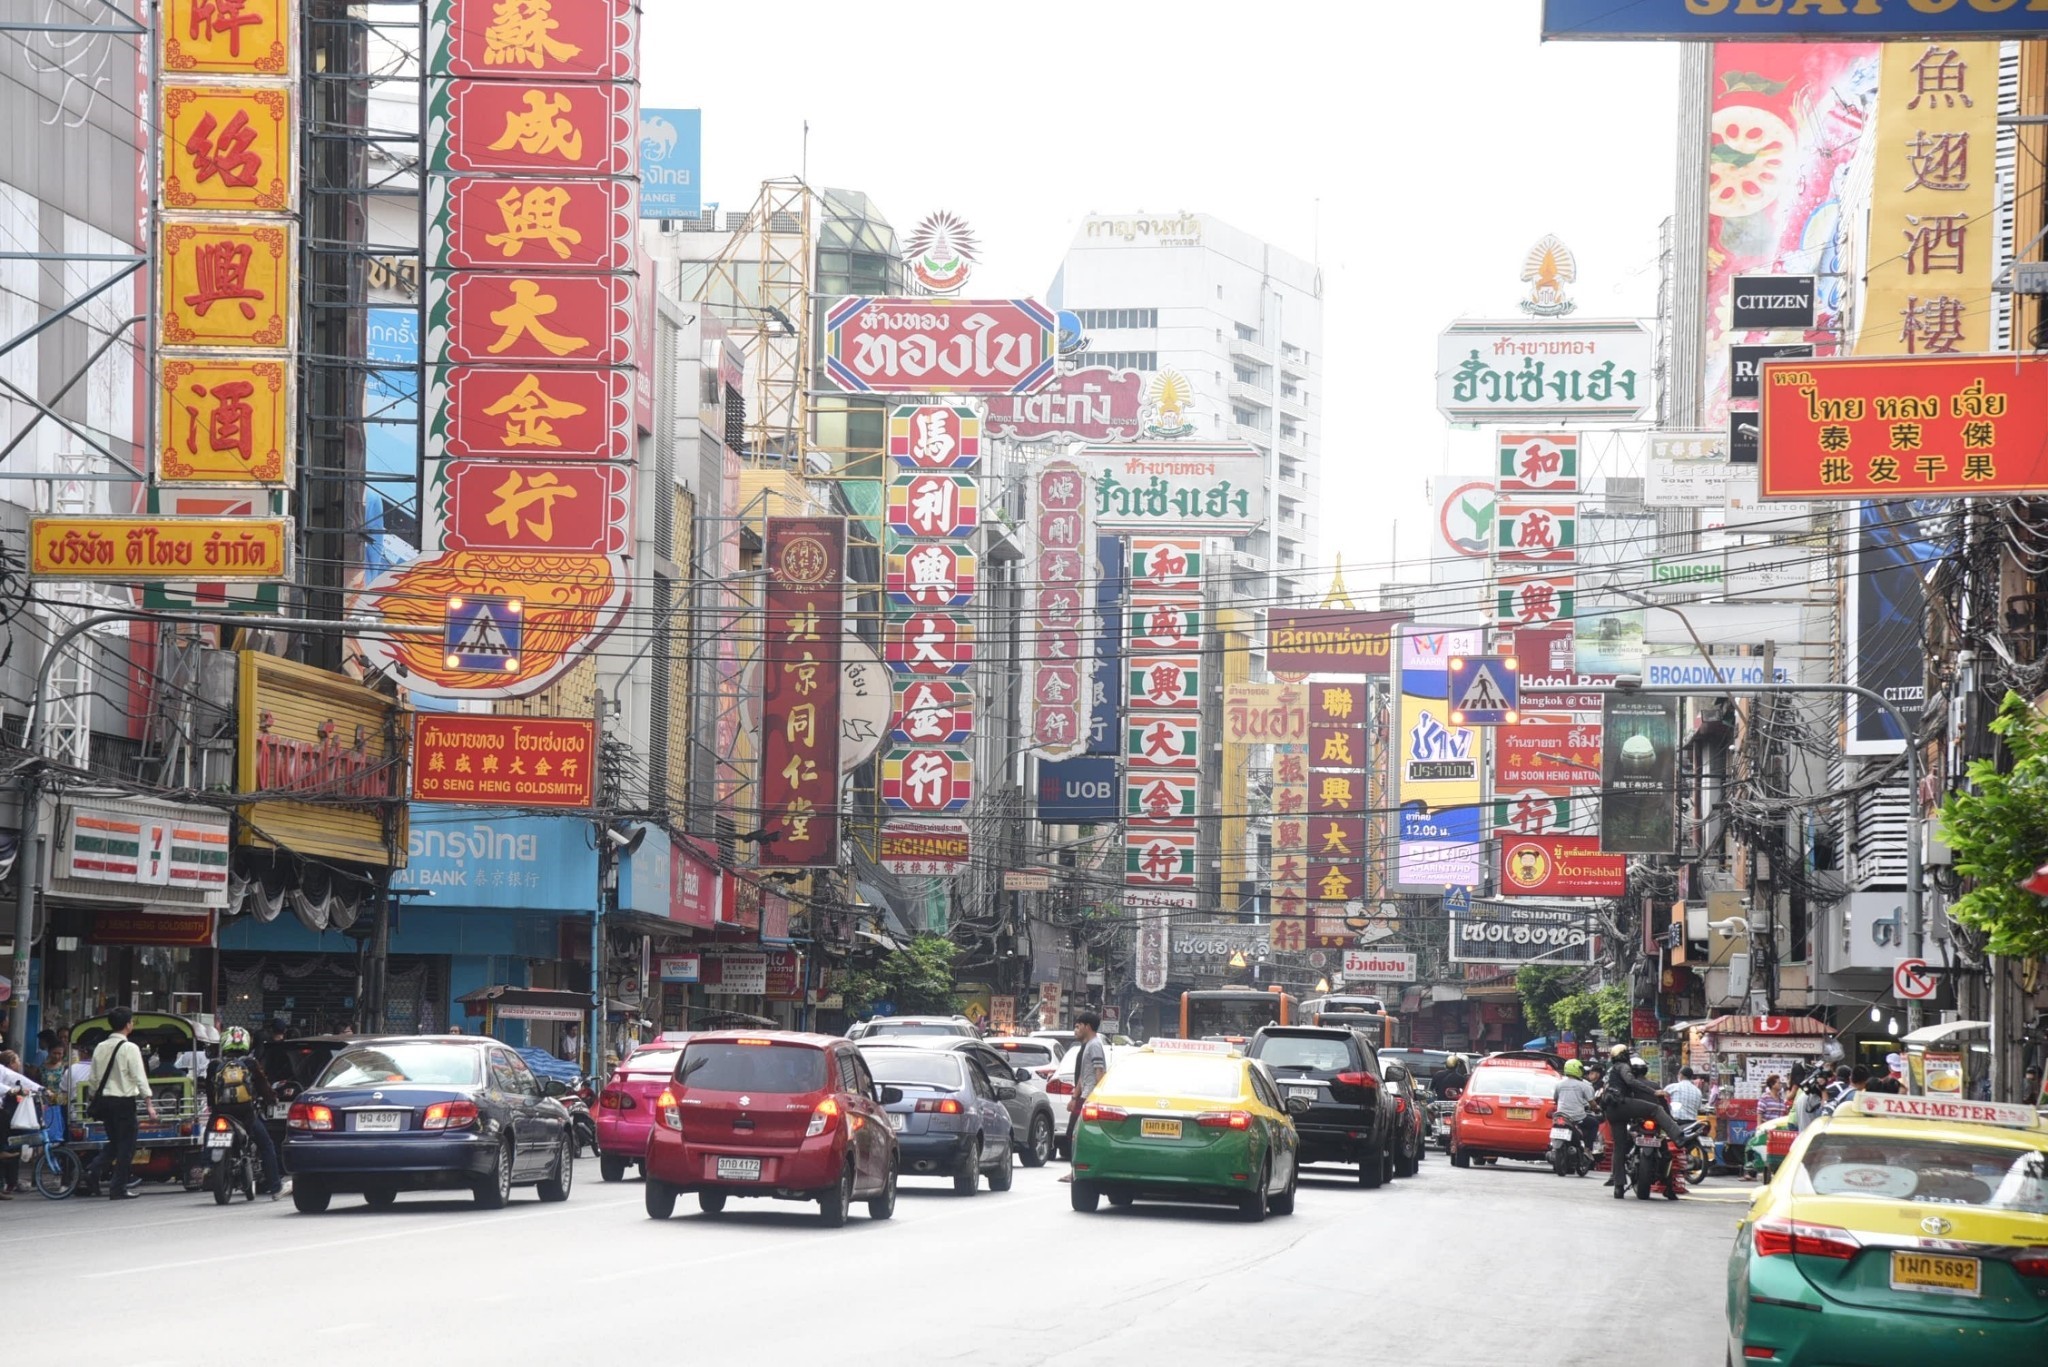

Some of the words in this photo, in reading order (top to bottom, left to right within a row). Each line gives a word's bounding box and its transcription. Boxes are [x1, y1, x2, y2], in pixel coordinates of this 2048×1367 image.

[1900, 45, 1974, 353] 魚翅酒樓
[1736, 294, 1808, 310] CITIZEN
[859, 305, 949, 331] ห้างทอง
[853, 313, 1033, 377] ทองใบ
[1493, 336, 1596, 355] ห้างขายทอง
[1453, 349, 1638, 403] ฮั่วเซ่งเฮง
[1773, 371, 1817, 386] หจก.
[1800, 387, 1863, 422] ไทย
[1875, 393, 1939, 420] หลง
[1951, 377, 2006, 418] เจี่ย
[1818, 421, 1995, 452] 泰荣傑
[1124, 457, 1216, 476] ห้างขายทอง
[1820, 453, 1996, 484] 批发干果
[1736, 503, 1807, 511] HAMILTON
[49, 530, 115, 566] บริษัท
[203, 530, 267, 566] จำกัด
[1453, 637, 1469, 649] 34
[1519, 674, 1571, 688] Hotel
[1650, 666, 1736, 685] BROADWAY
[1742, 667, 1788, 684] HOEL
[1520, 695, 1564, 708] Bangkok
[1565, 695, 1577, 708] @
[781, 601, 822, 842] 北京同仁堂
[1142, 547, 1186, 881] 和成興大金行
[424, 726, 505, 750] ห้างขายทอง
[1504, 734, 1563, 748] ร้านขายยา
[427, 751, 579, 778] 蘇成興大金行
[1411, 761, 1472, 778] ประจำบ้าน
[1503, 770, 1519, 781] LIM
[1521, 771, 1546, 781] SOON
[1547, 771, 1571, 782] HENG
[422, 777, 440, 790] SO
[442, 778, 475, 791] SENG
[478, 780, 512, 793] HENG
[515, 781, 584, 796] GOLDSMITH
[1065, 781, 1112, 799] UOB
[1318, 688, 1353, 946] 聯成興大金
[1405, 824, 1437, 836] 12.00
[881, 838, 968, 856] EXCHANGE
[419, 870, 468, 886] BANK
[473, 870, 541, 889] 泰京銀行
[1582, 867, 1622, 877] Fishball
[157, 919, 206, 932] GOLDSMITH
[1772, 1041, 1815, 1050] SEAFOOD
[375, 1113, 398, 1123] 4307
[1884, 1099, 1997, 1121] TAXI-METER
[1161, 1122, 1180, 1131] 8134
[738, 1160, 760, 1170] 4172
[1898, 1256, 1931, 1275] 1มก
[1934, 1259, 1975, 1280] 5692
